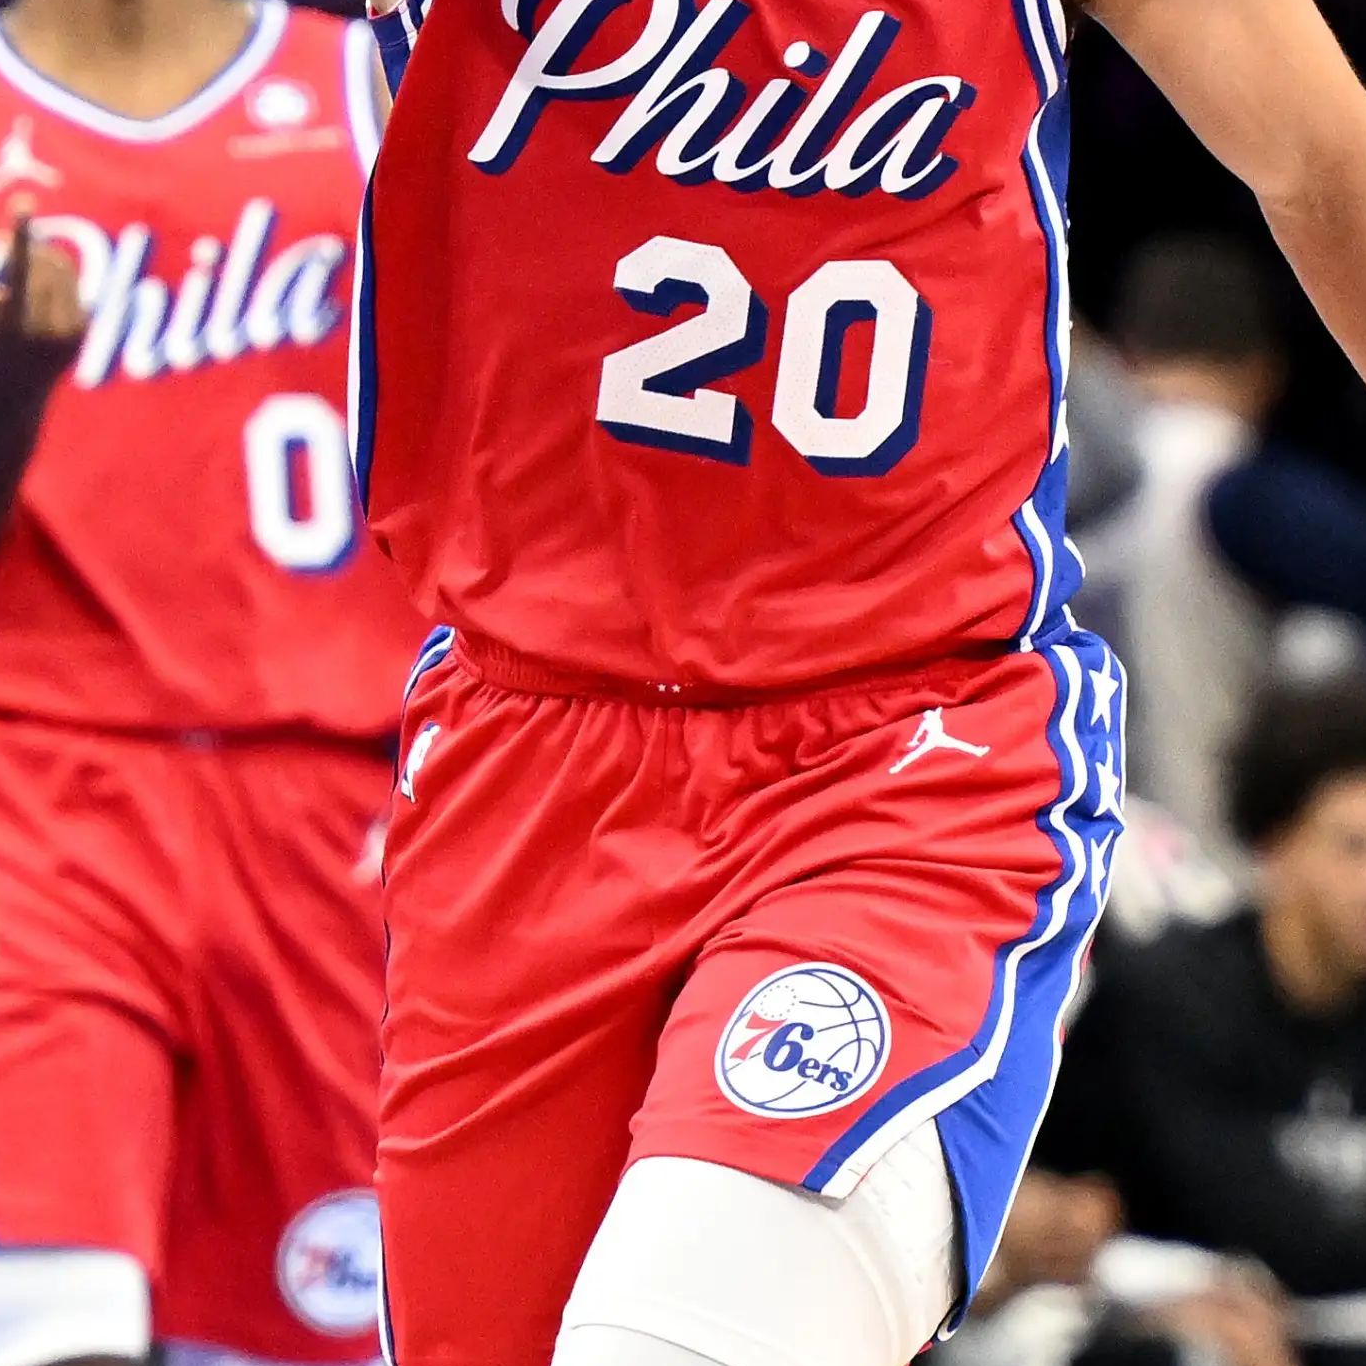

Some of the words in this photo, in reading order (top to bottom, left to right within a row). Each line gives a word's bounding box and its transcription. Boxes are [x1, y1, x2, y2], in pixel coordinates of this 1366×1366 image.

[596, 235, 933, 477] 20
[243, 391, 356, 572] 0
[730, 1011, 853, 1092] 76ers
